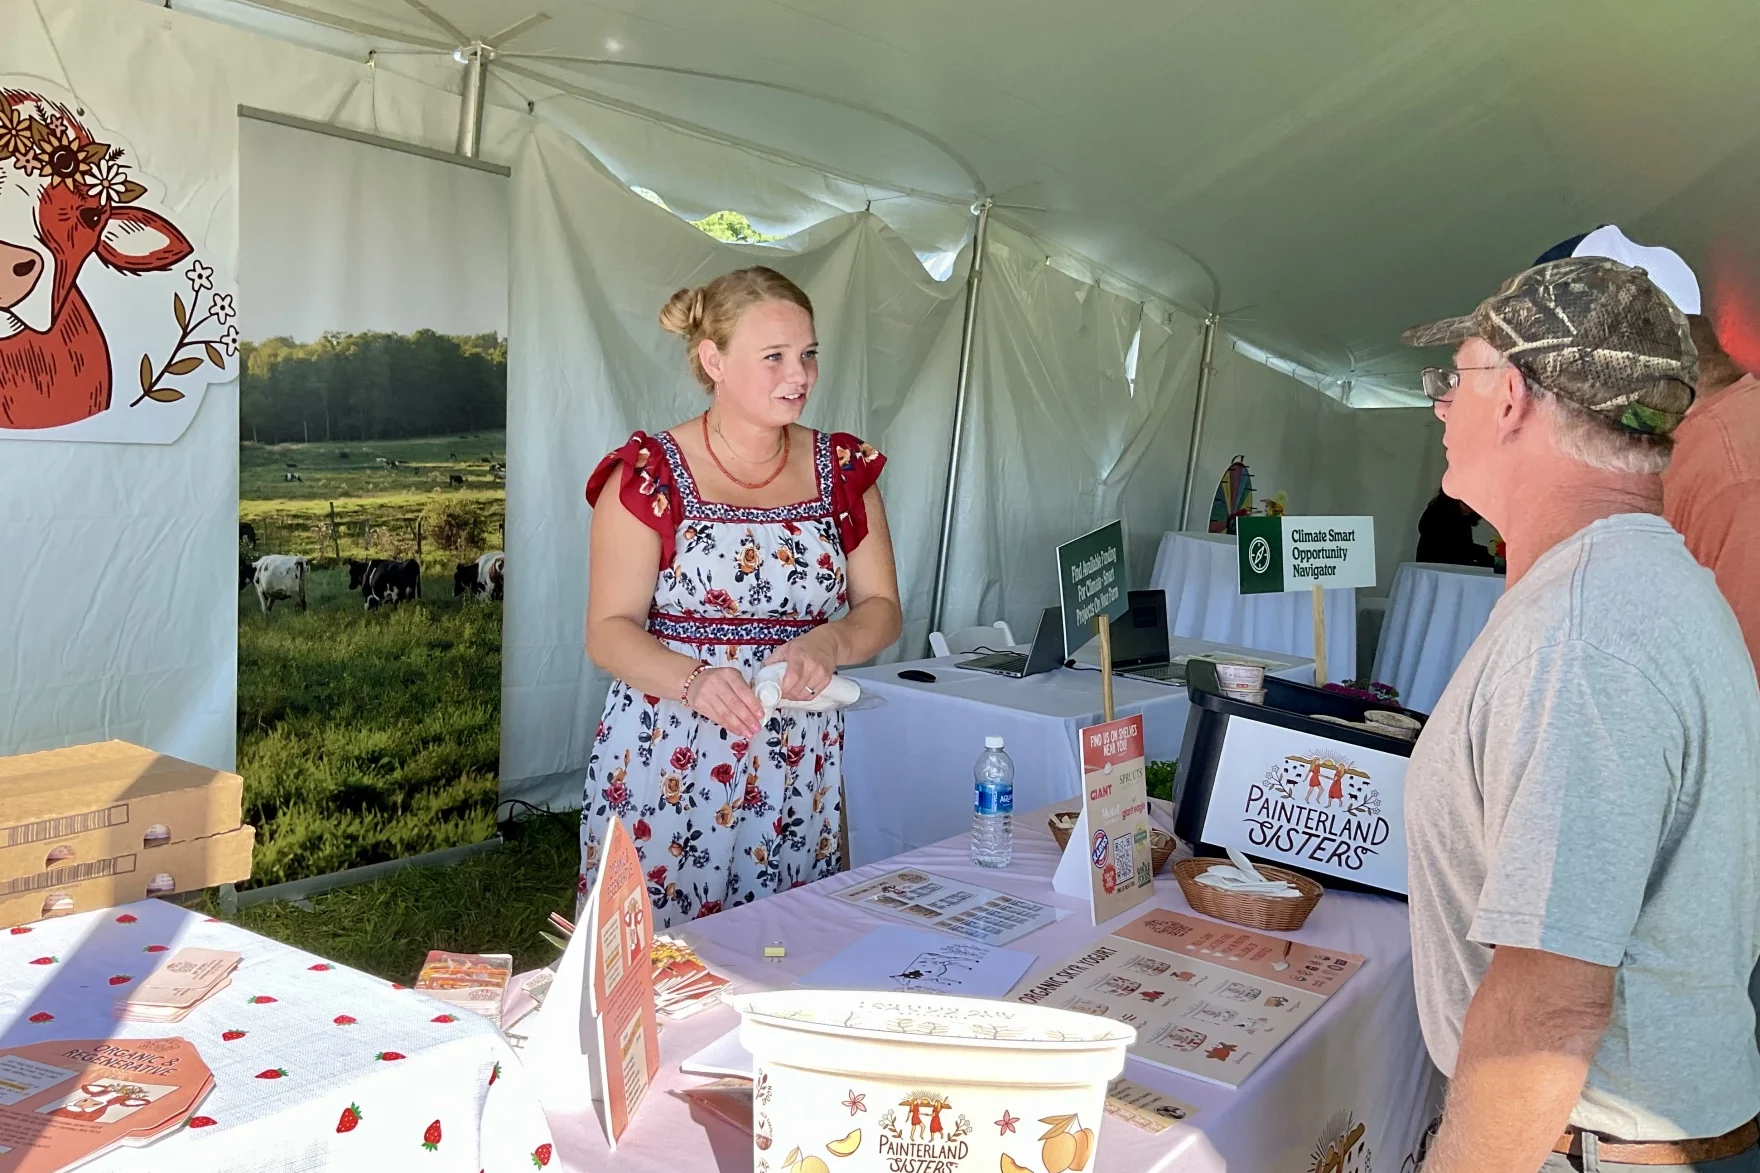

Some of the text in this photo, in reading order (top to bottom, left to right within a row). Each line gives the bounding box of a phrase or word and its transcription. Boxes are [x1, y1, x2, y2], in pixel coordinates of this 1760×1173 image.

[1291, 528, 1356, 543] Climate Smart
[1071, 561, 1082, 583] Find
[1101, 546, 1117, 568] Funding
[1292, 545, 1348, 563] Opportunity
[1292, 563, 1337, 580] Navigator
[1076, 604, 1095, 627] Projects
[1090, 724, 1138, 748] FIND US ON SHELVES
[1103, 742, 1117, 756] NEAR
[1090, 784, 1112, 801] GIANT
[1245, 784, 1390, 846] PAINTERLAND
[1243, 818, 1379, 871] SISTERS
[1018, 946, 1118, 1004] ORGANIC SKYR YOGURT
[62, 1048, 179, 1077] REGENERATIVE
[93, 1044, 164, 1064] ORGANIC
[164, 1057, 180, 1067] &
[879, 1134, 968, 1160] PAINTERLAND
[886, 1157, 958, 1173] SISTERS
